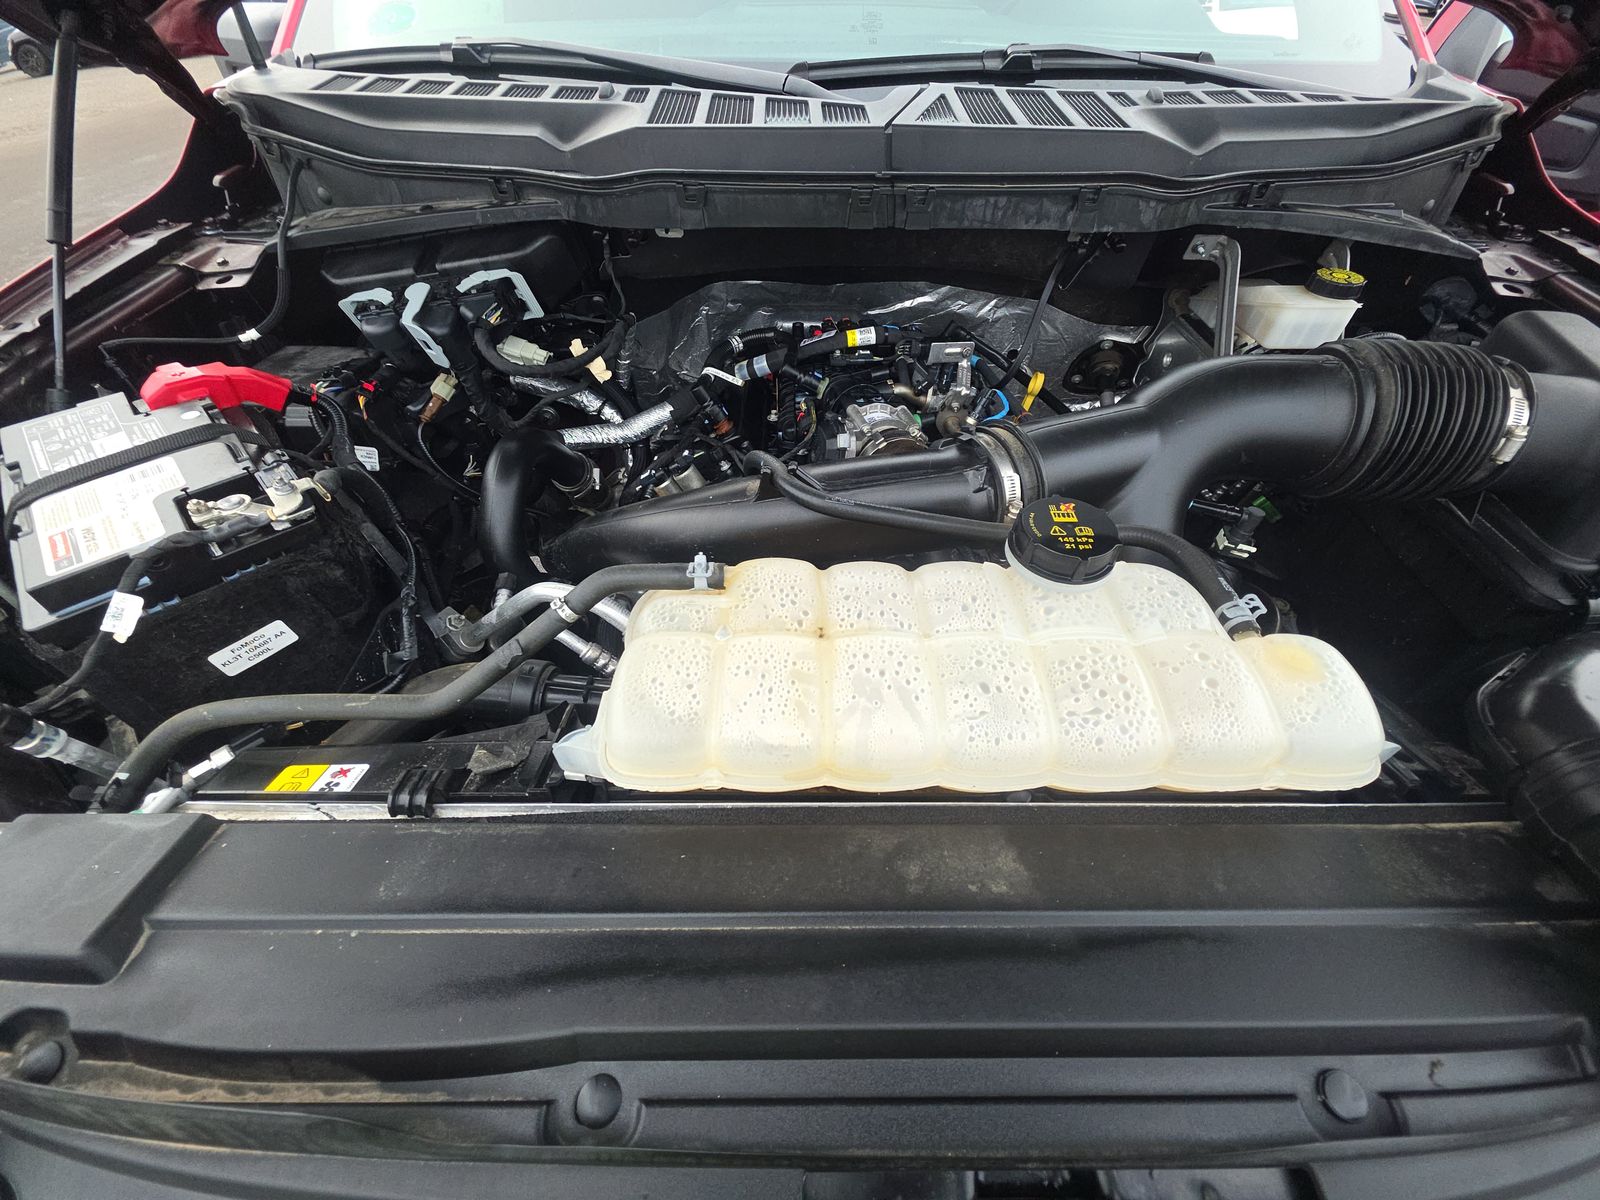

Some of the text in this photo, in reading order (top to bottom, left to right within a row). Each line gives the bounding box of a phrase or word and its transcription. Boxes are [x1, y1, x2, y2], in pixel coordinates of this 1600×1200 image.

[221, 654, 243, 667] KL3T
[275, 630, 286, 639] AA
[230, 634, 266, 654] FoMoCo
